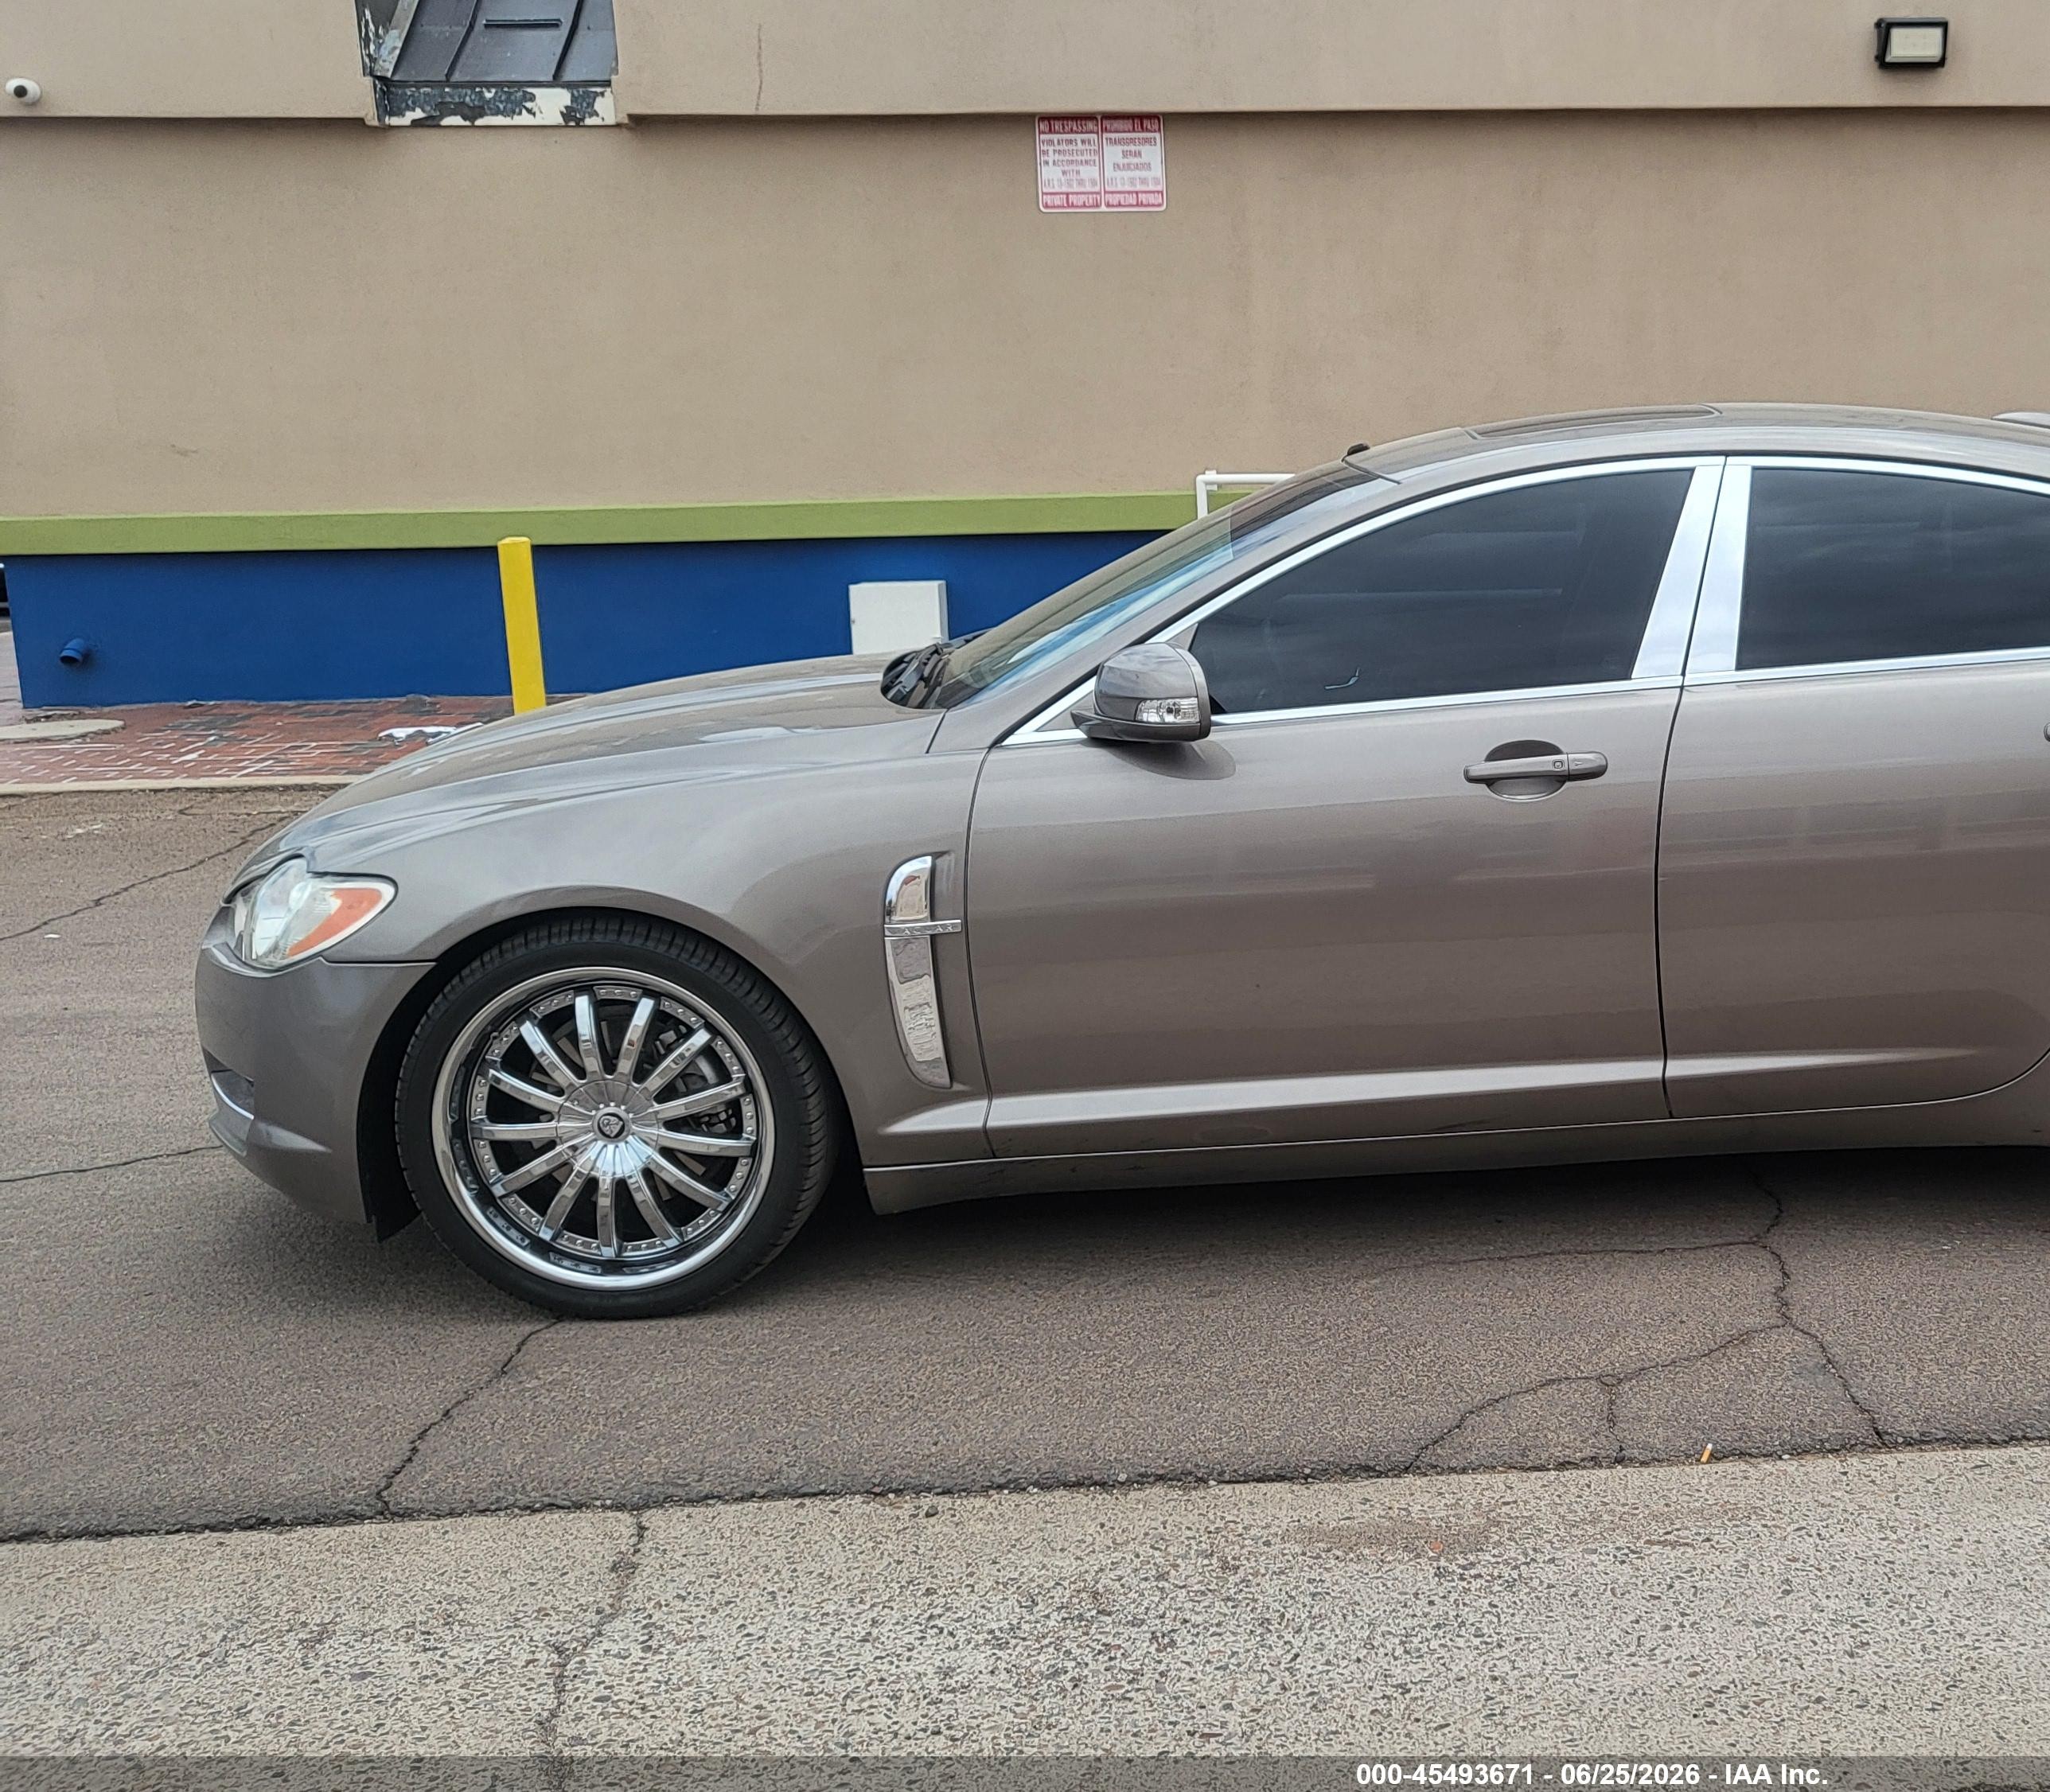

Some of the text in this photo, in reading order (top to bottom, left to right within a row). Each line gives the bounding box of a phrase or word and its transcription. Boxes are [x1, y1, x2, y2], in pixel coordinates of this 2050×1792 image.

[1039, 119, 1098, 133] NO TRESPASSING
[1134, 119, 1142, 131] EL
[1144, 118, 1159, 131] PASO
[1105, 136, 1157, 146] TRANSGRESORES
[1053, 158, 1097, 167] ACCORDANCE
[897, 924, 953, 935] AGUAR
